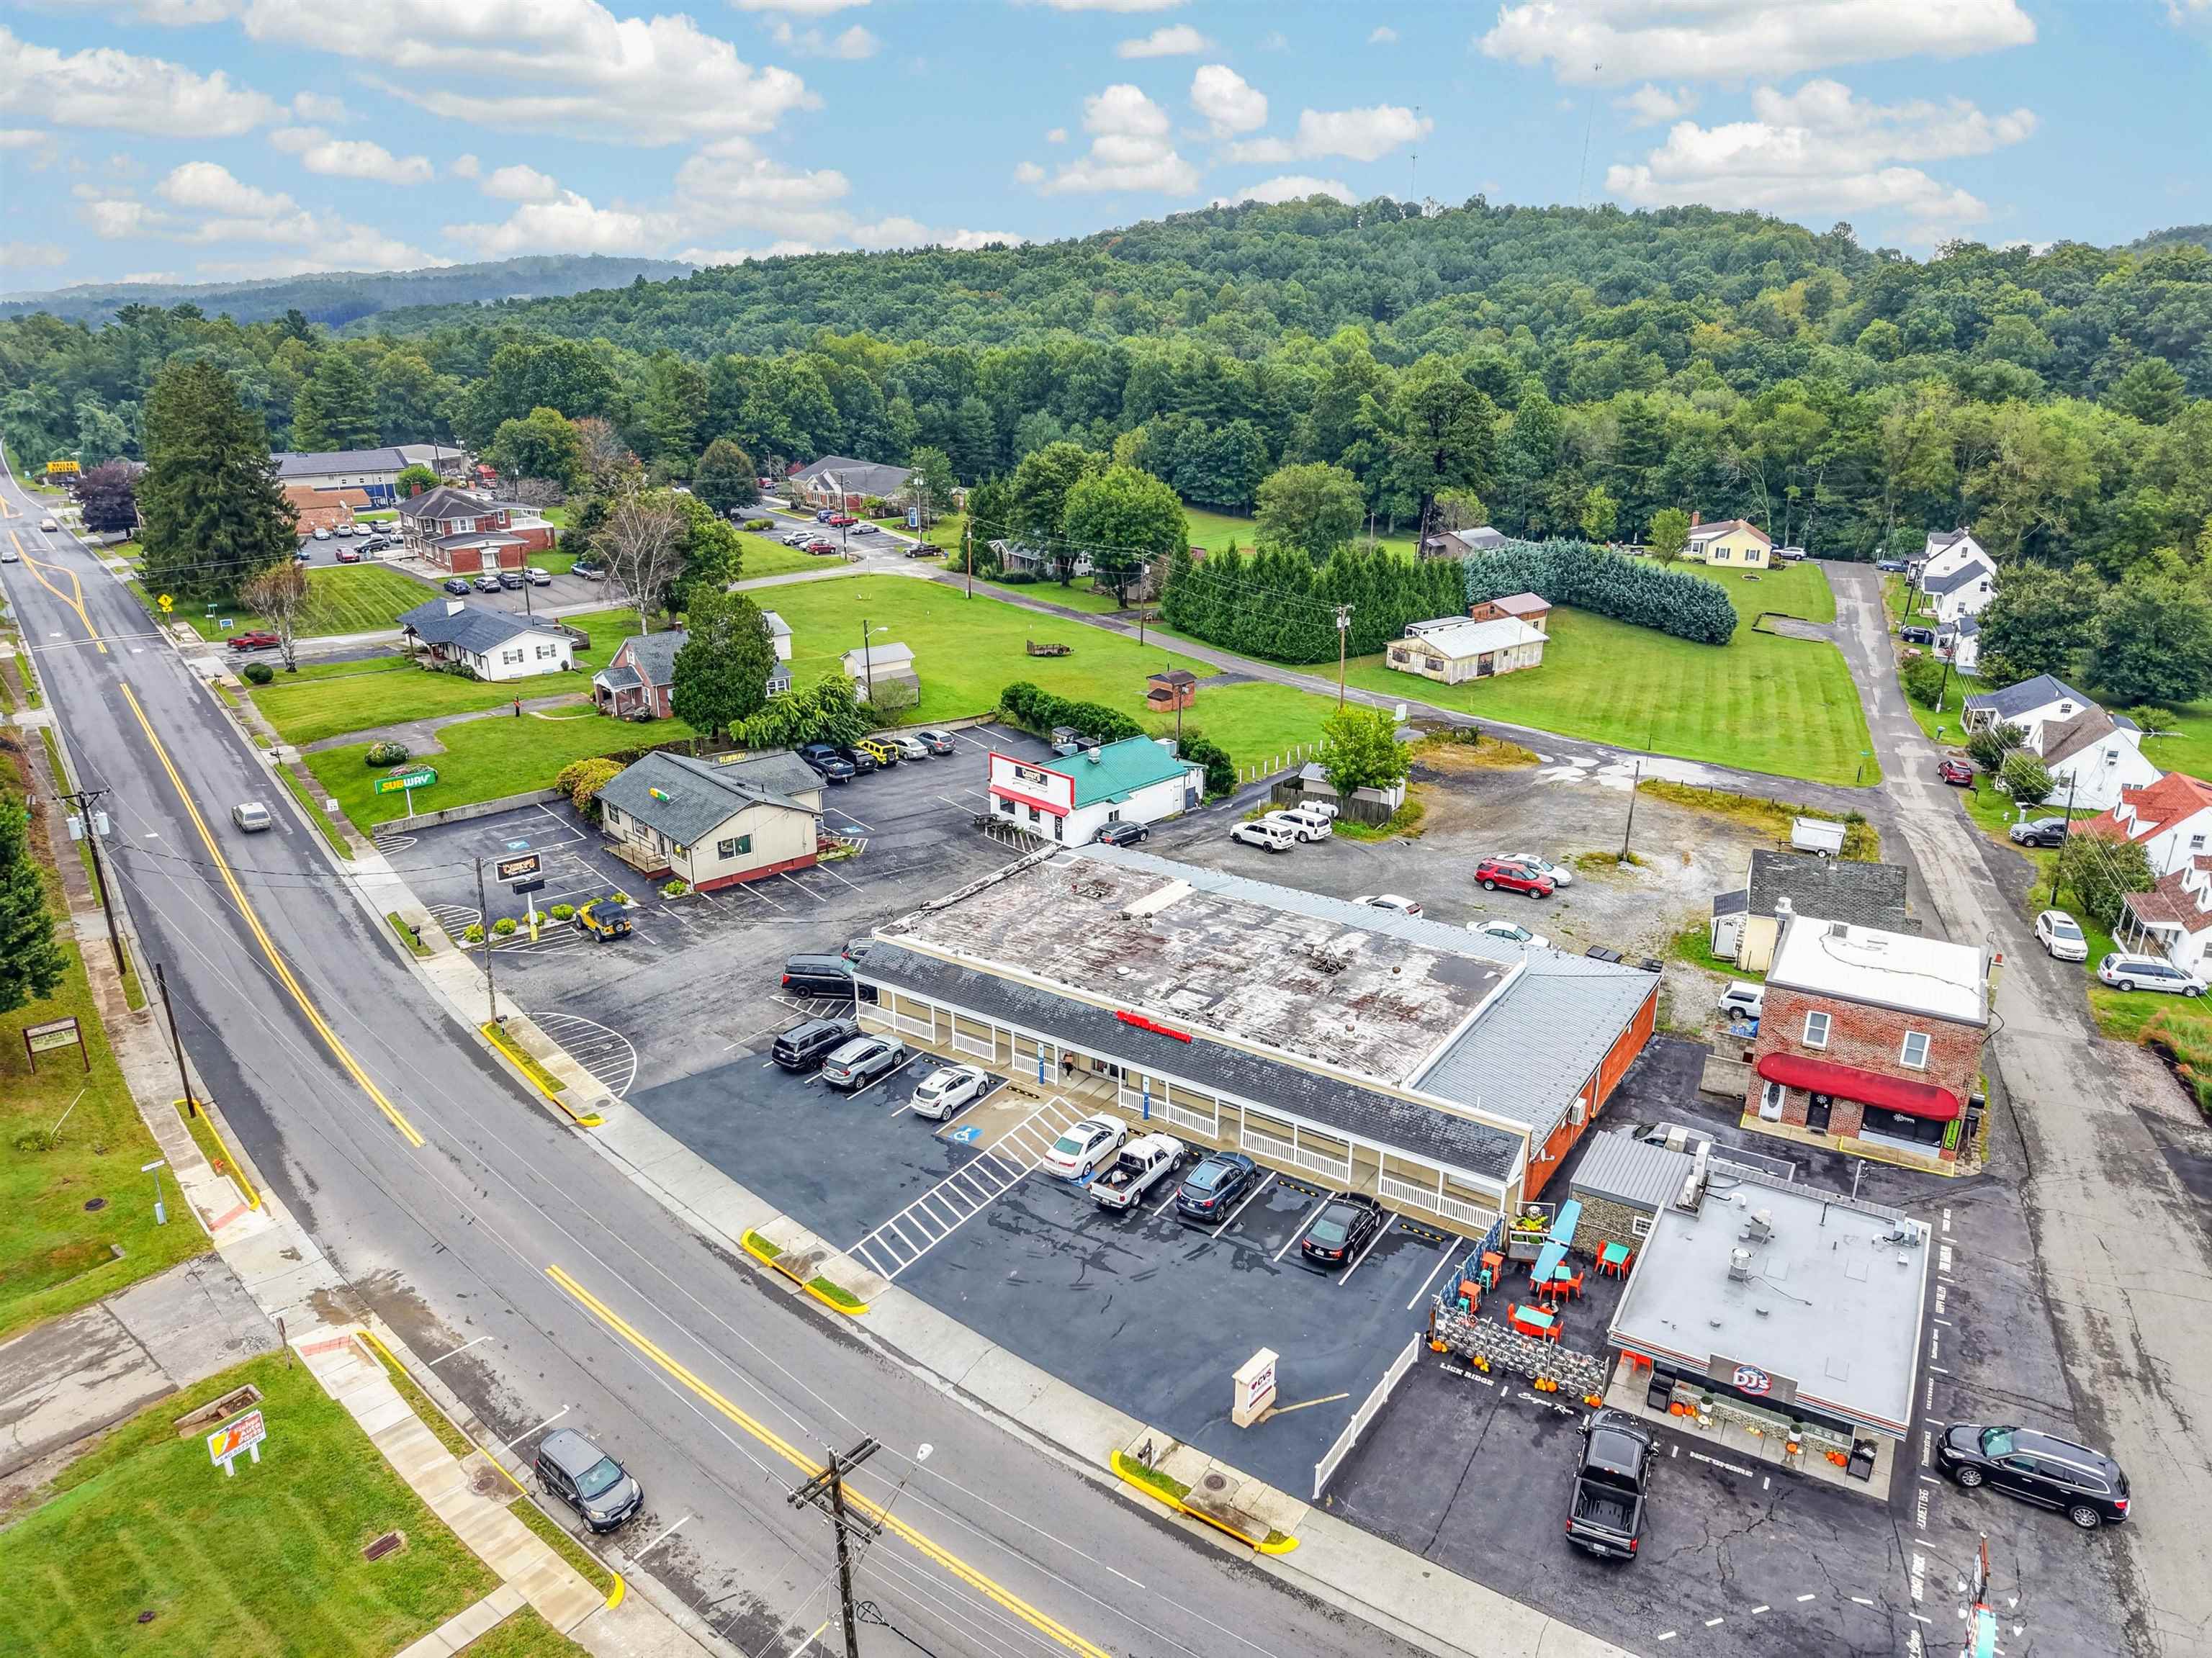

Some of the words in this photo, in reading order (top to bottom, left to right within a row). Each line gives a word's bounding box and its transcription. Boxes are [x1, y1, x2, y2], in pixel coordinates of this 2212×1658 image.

[382, 773, 431, 790] SUBWAY
[1946, 1119, 1956, 1148] 115
[1257, 1368, 1272, 1386] CVS
[1439, 1362, 1463, 1377] LICK
[1463, 1371, 1495, 1387] RIDGE
[1517, 1392, 1553, 1407] Sugar
[1552, 1402, 1575, 1415] Run
